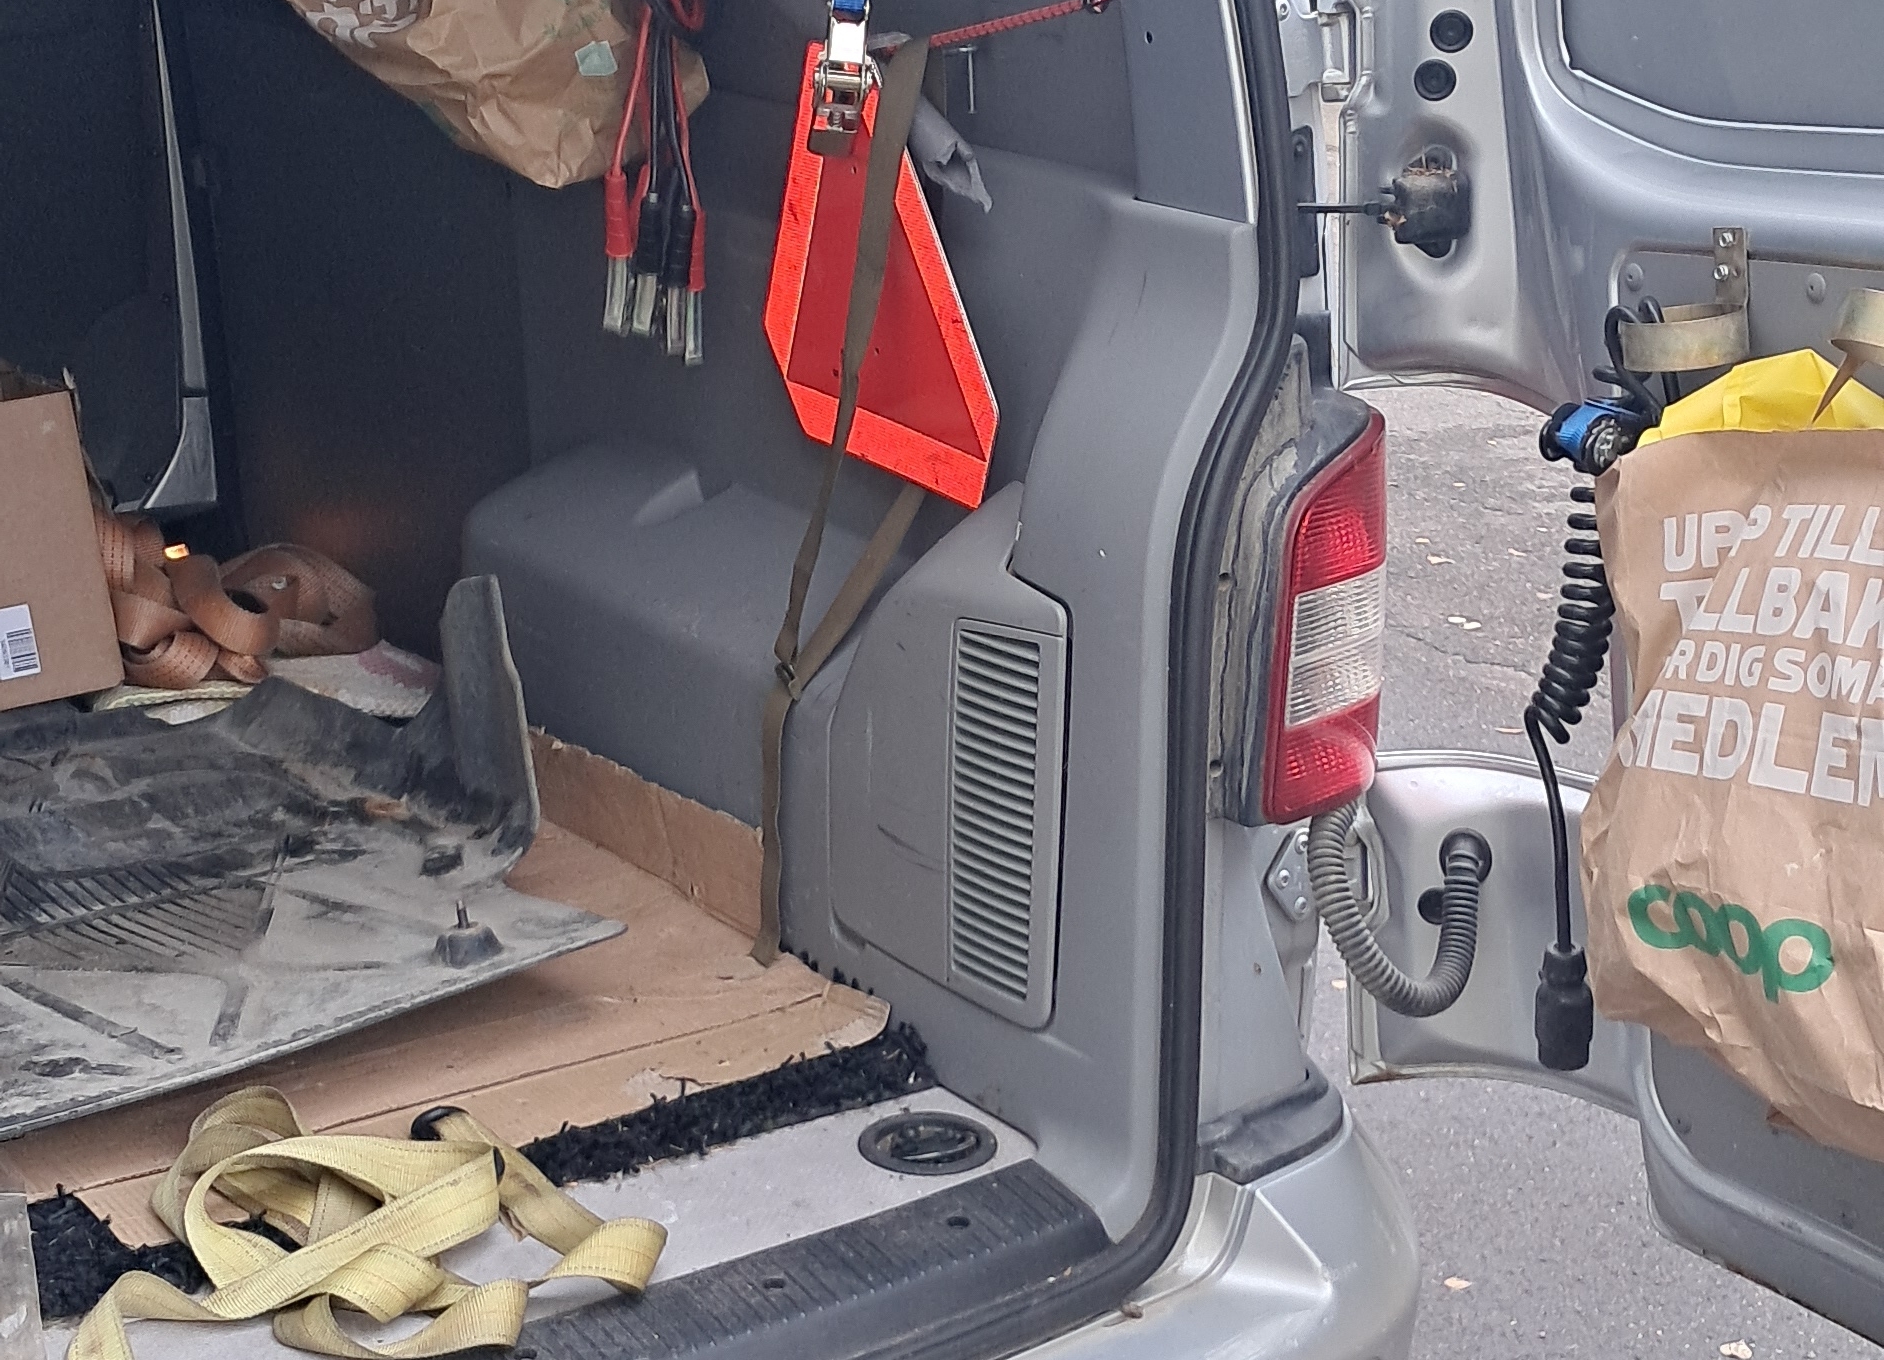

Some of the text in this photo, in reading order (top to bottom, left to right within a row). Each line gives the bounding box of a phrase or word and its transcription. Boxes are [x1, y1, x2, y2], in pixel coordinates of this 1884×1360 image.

[1663, 504, 1884, 573] UPP TILL
[1695, 640, 1767, 688] DIG
[1767, 646, 1872, 704] SOM
